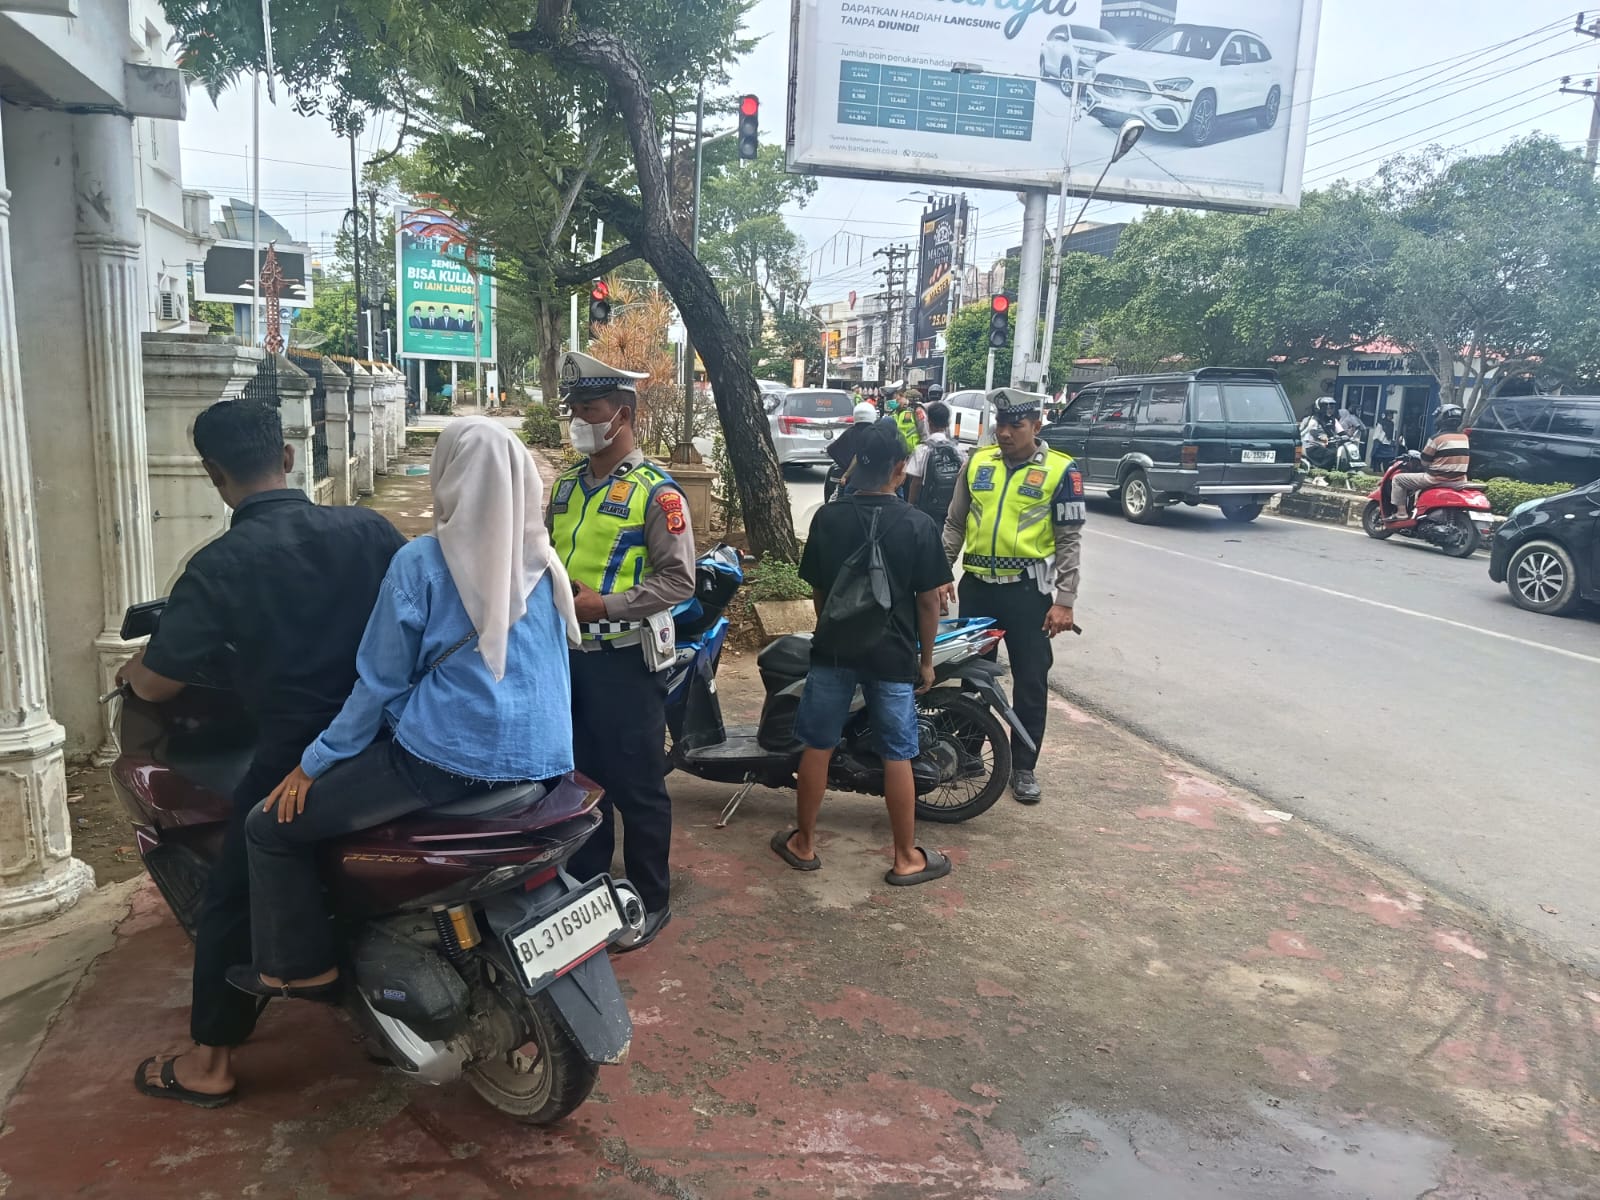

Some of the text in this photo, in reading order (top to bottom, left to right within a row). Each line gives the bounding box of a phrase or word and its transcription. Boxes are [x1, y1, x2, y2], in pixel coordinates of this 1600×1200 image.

[841, 2, 1001, 30] DAPATKAN HADIAH LANGSUNG
[841, 16, 920, 33] TANPA DIUNDI!
[841, 48, 868, 59] Jumlah
[869, 52, 887, 61] poin
[887, 54, 929, 65] penukaran
[431, 259, 461, 270] SEMUA
[407, 266, 437, 281] BISA
[413, 280, 423, 290] DI
[424, 281, 443, 291] IAIN
